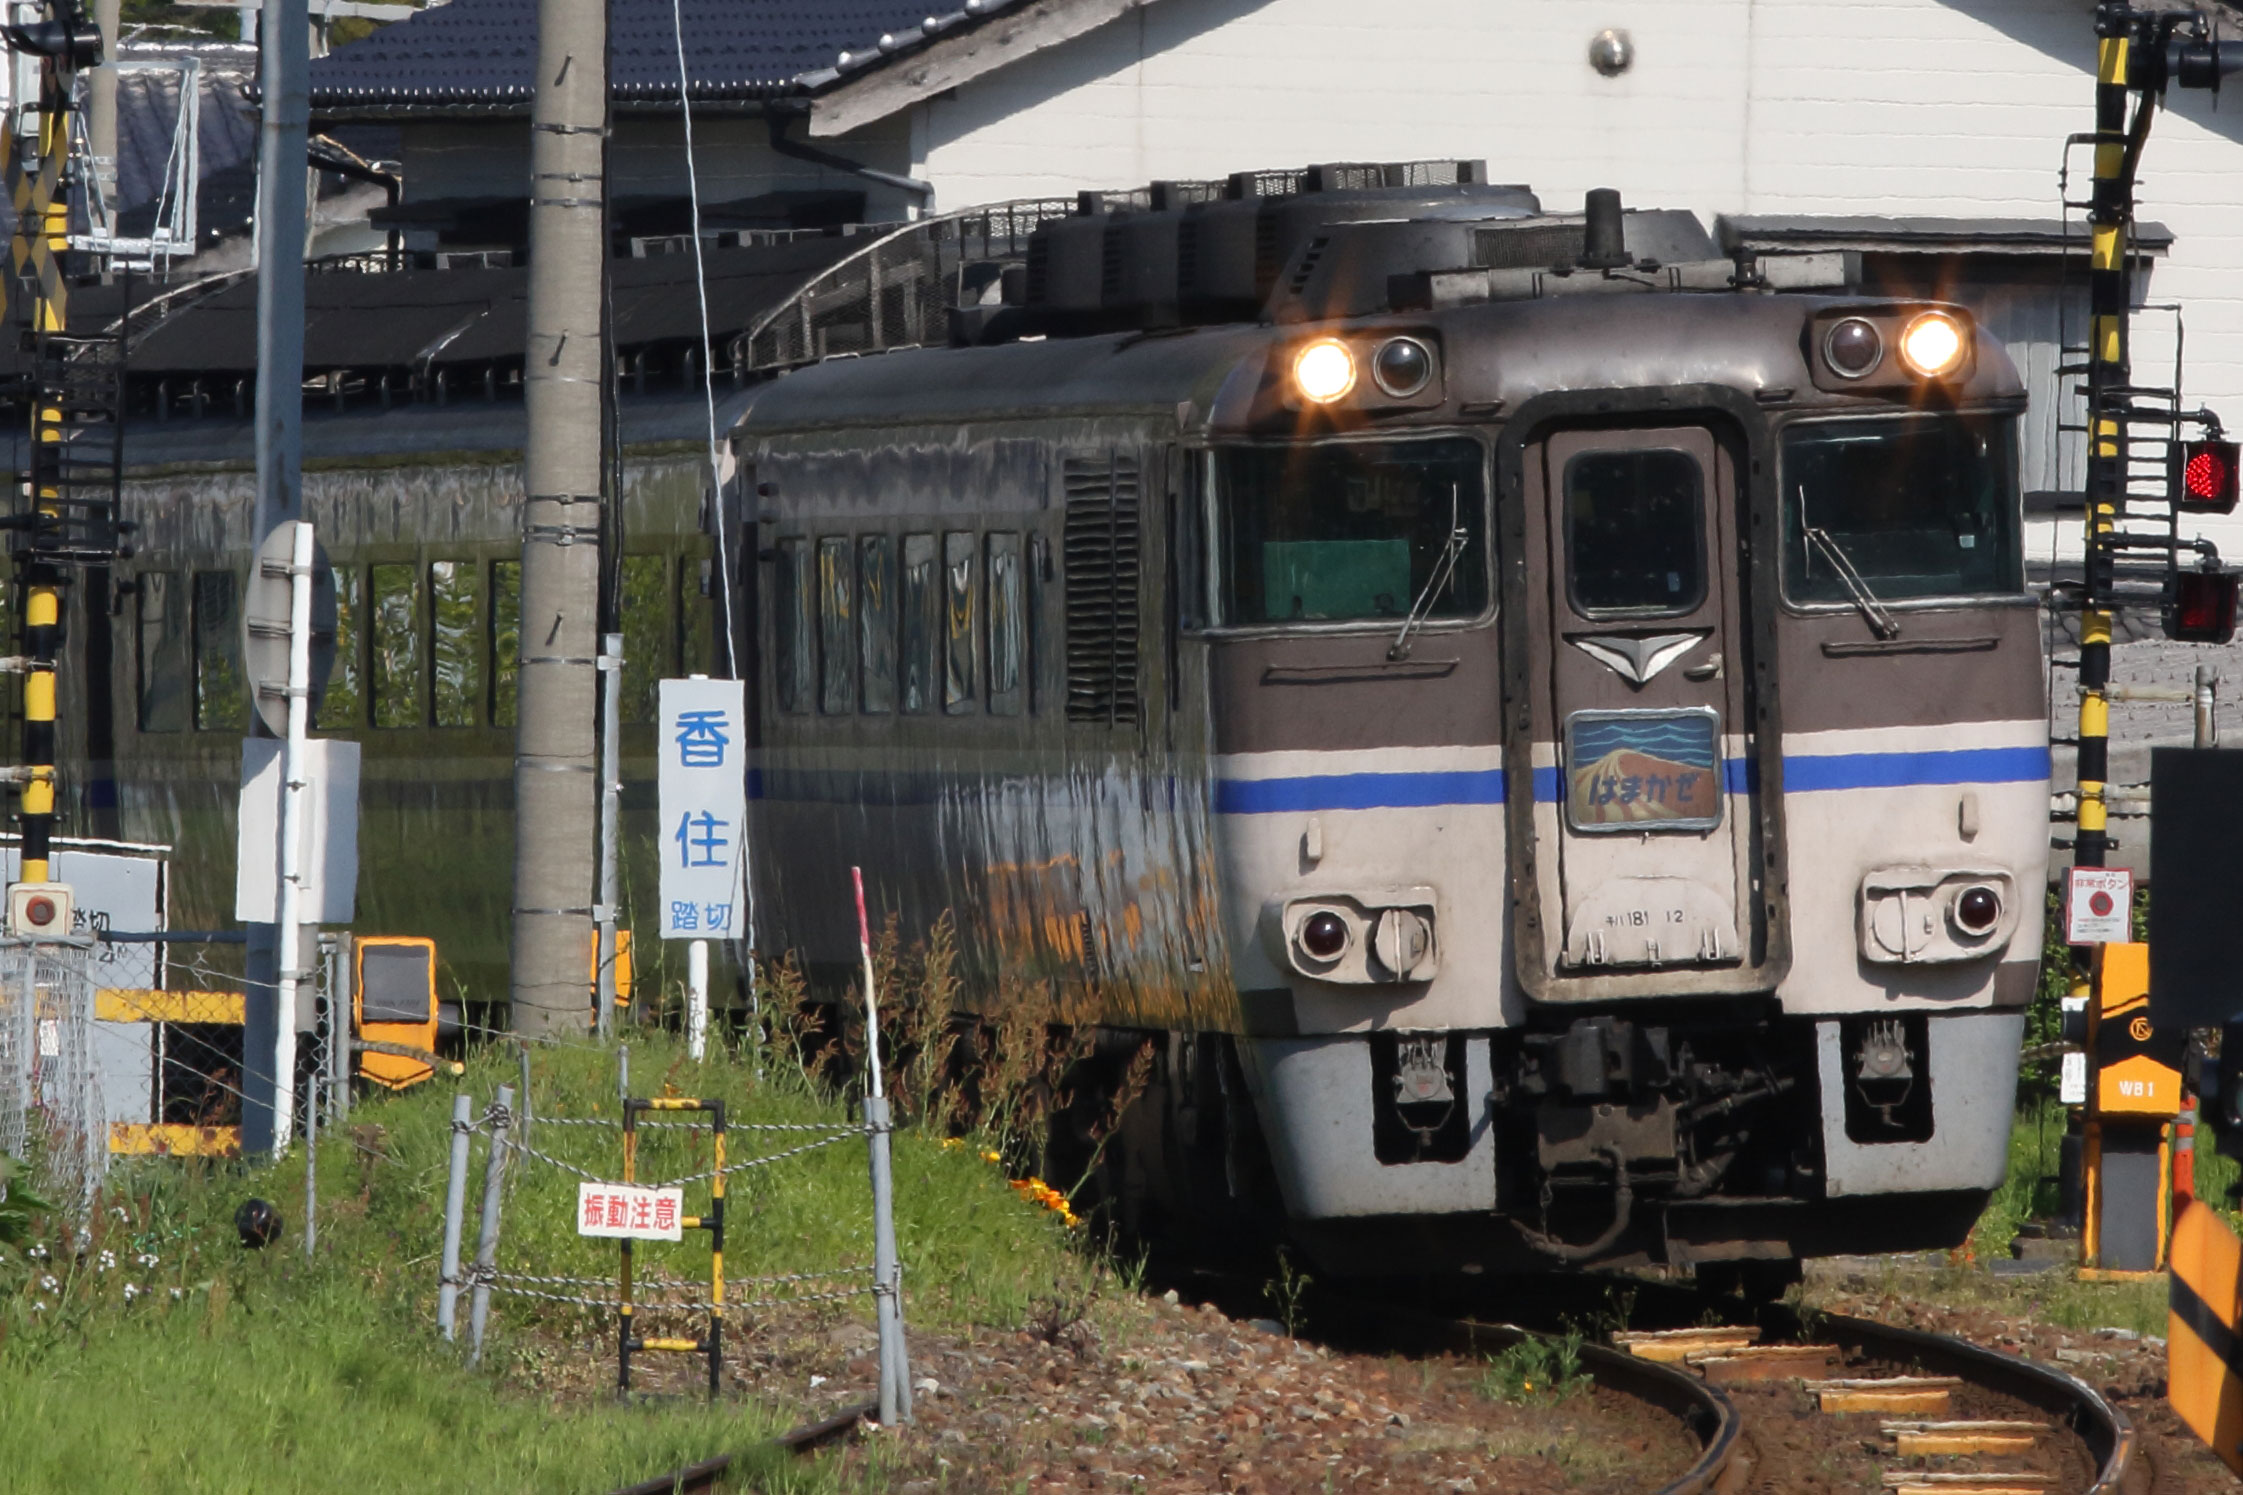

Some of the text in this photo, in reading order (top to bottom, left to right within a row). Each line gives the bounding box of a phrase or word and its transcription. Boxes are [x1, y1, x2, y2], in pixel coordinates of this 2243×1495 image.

[675, 710, 730, 868] 香住
[1588, 772, 1698, 806] はまかぜ
[672, 901, 731, 930] 踏切
[584, 1192, 676, 1230] 振動注意
